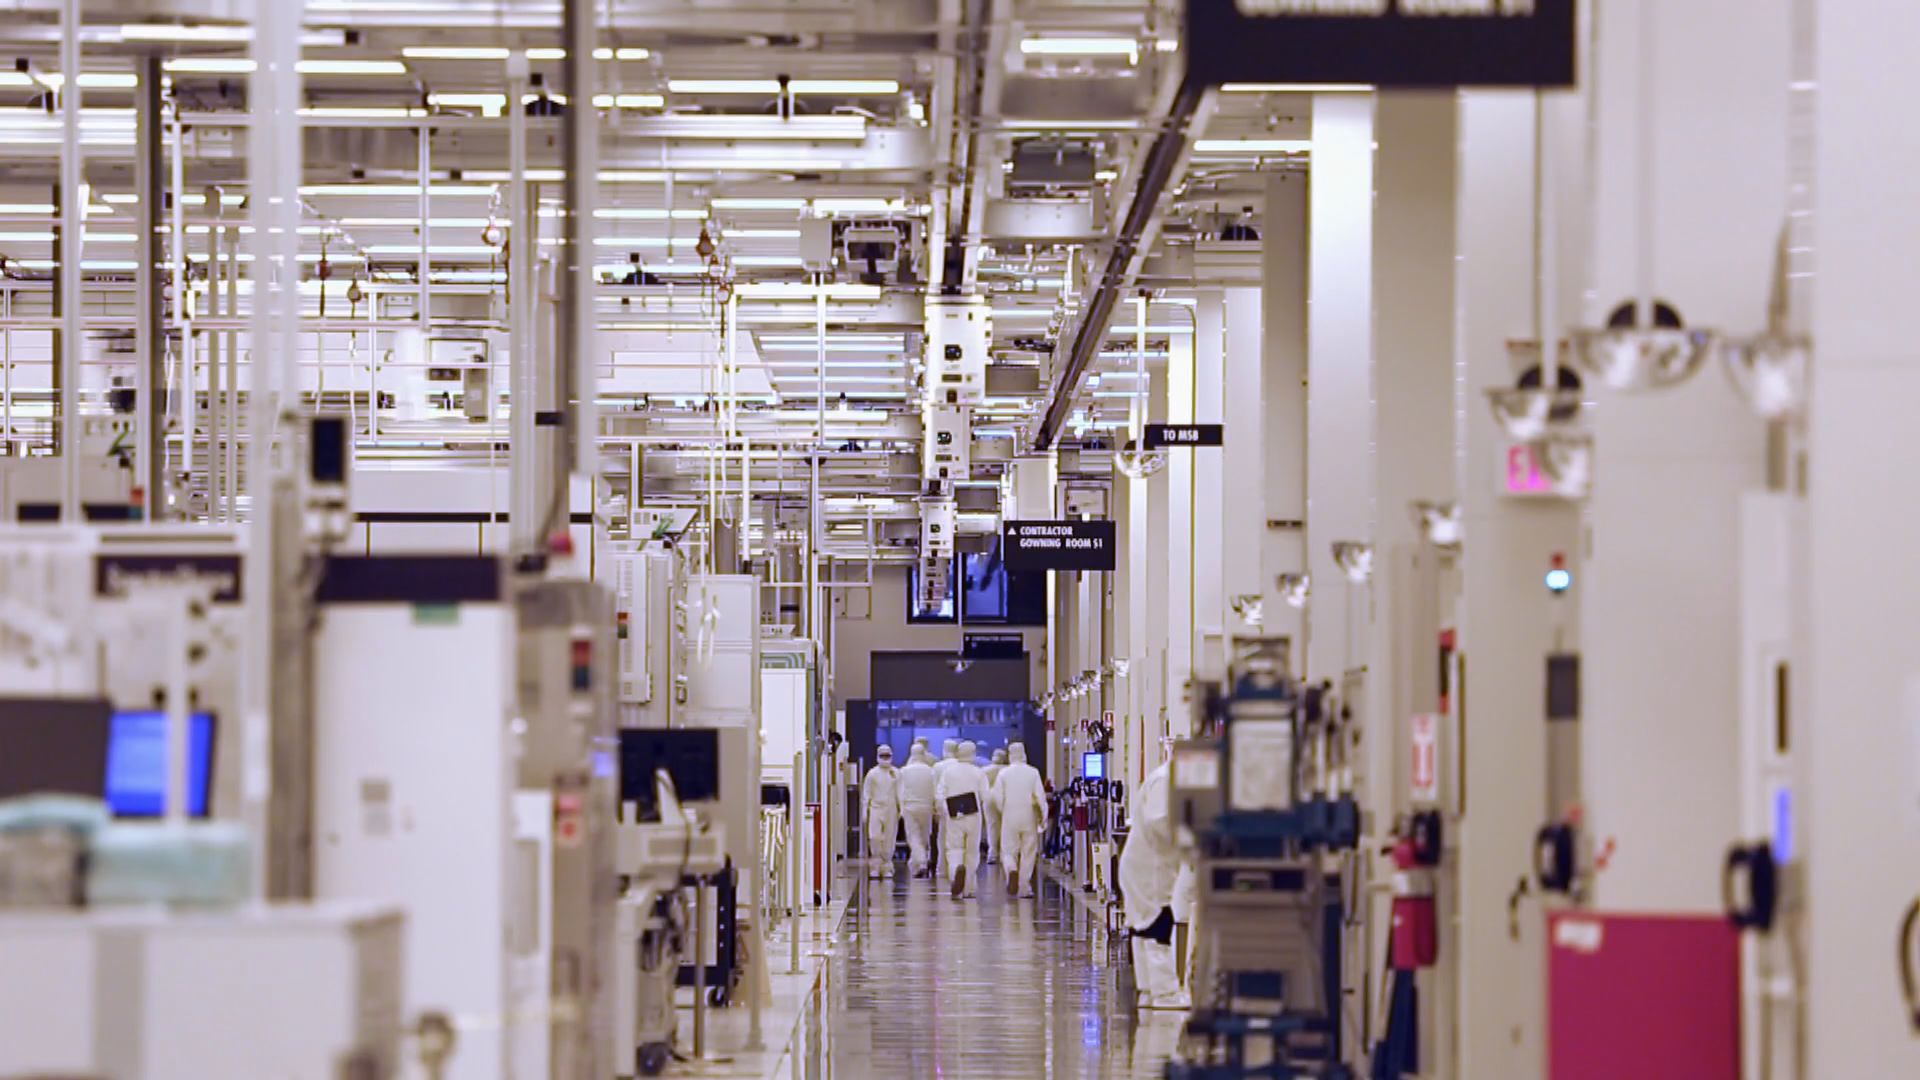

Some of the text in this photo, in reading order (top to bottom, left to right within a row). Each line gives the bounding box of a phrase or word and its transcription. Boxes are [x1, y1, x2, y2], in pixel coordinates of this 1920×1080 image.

[1163, 429, 1199, 441] TO MSB
[1020, 526, 1073, 535] CONTRACTOR
[1020, 538, 1061, 548] GOWNING
[1065, 538, 1091, 548] ROOM
